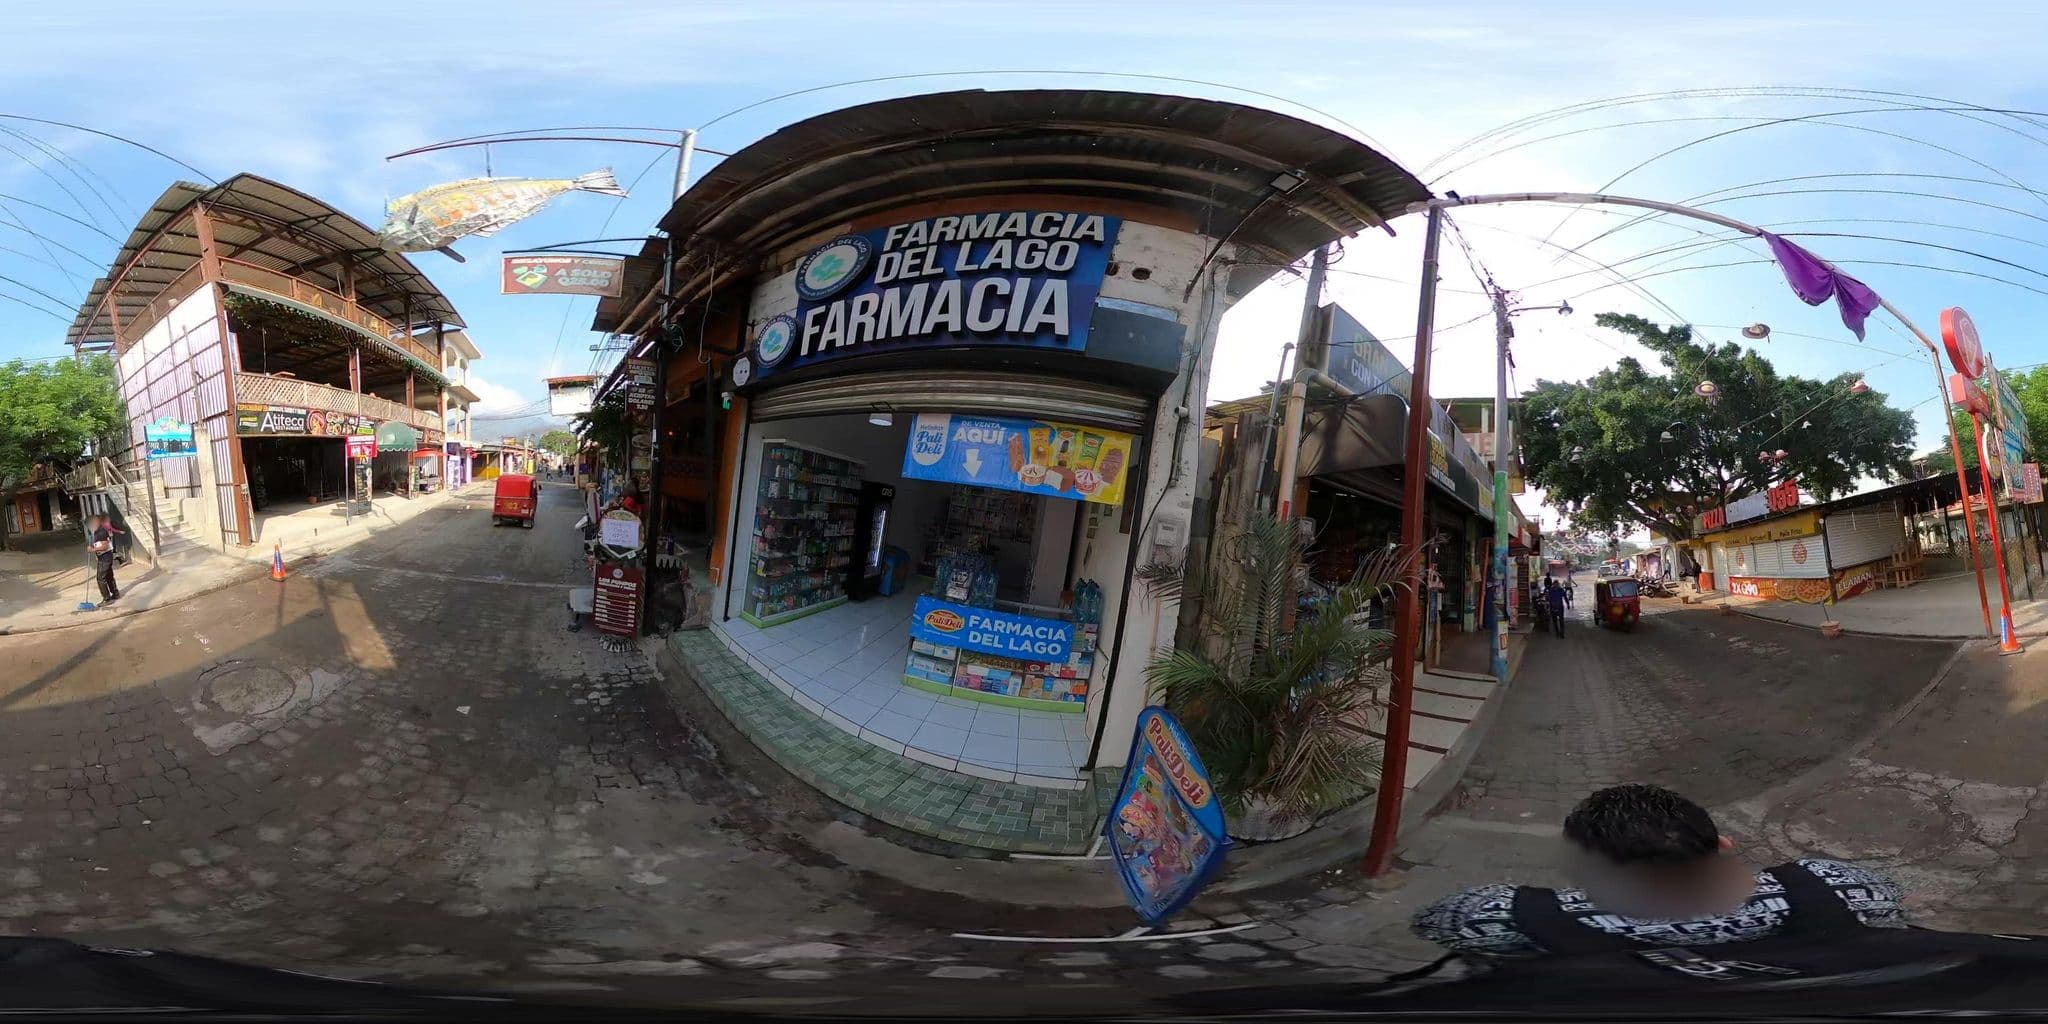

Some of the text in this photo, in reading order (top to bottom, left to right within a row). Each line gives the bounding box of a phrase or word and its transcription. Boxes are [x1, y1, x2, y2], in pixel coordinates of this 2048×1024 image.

[883, 211, 1105, 251] FARMACIA
[874, 244, 944, 284] DEL
[954, 238, 1080, 272] LAGO
[555, 268, 569, 277] A
[800, 277, 1070, 357] FARMACIA
[261, 412, 304, 433] Atiteca
[961, 420, 1001, 430] DE VENTA
[916, 430, 944, 444] Pali
[953, 427, 1007, 445] AQUÍ
[915, 442, 943, 455] Deli
[1702, 507, 1726, 529] PIZZA
[967, 615, 1067, 642] FARMACIA
[967, 631, 1004, 649] DEL
[1008, 637, 1062, 656] LAGO
